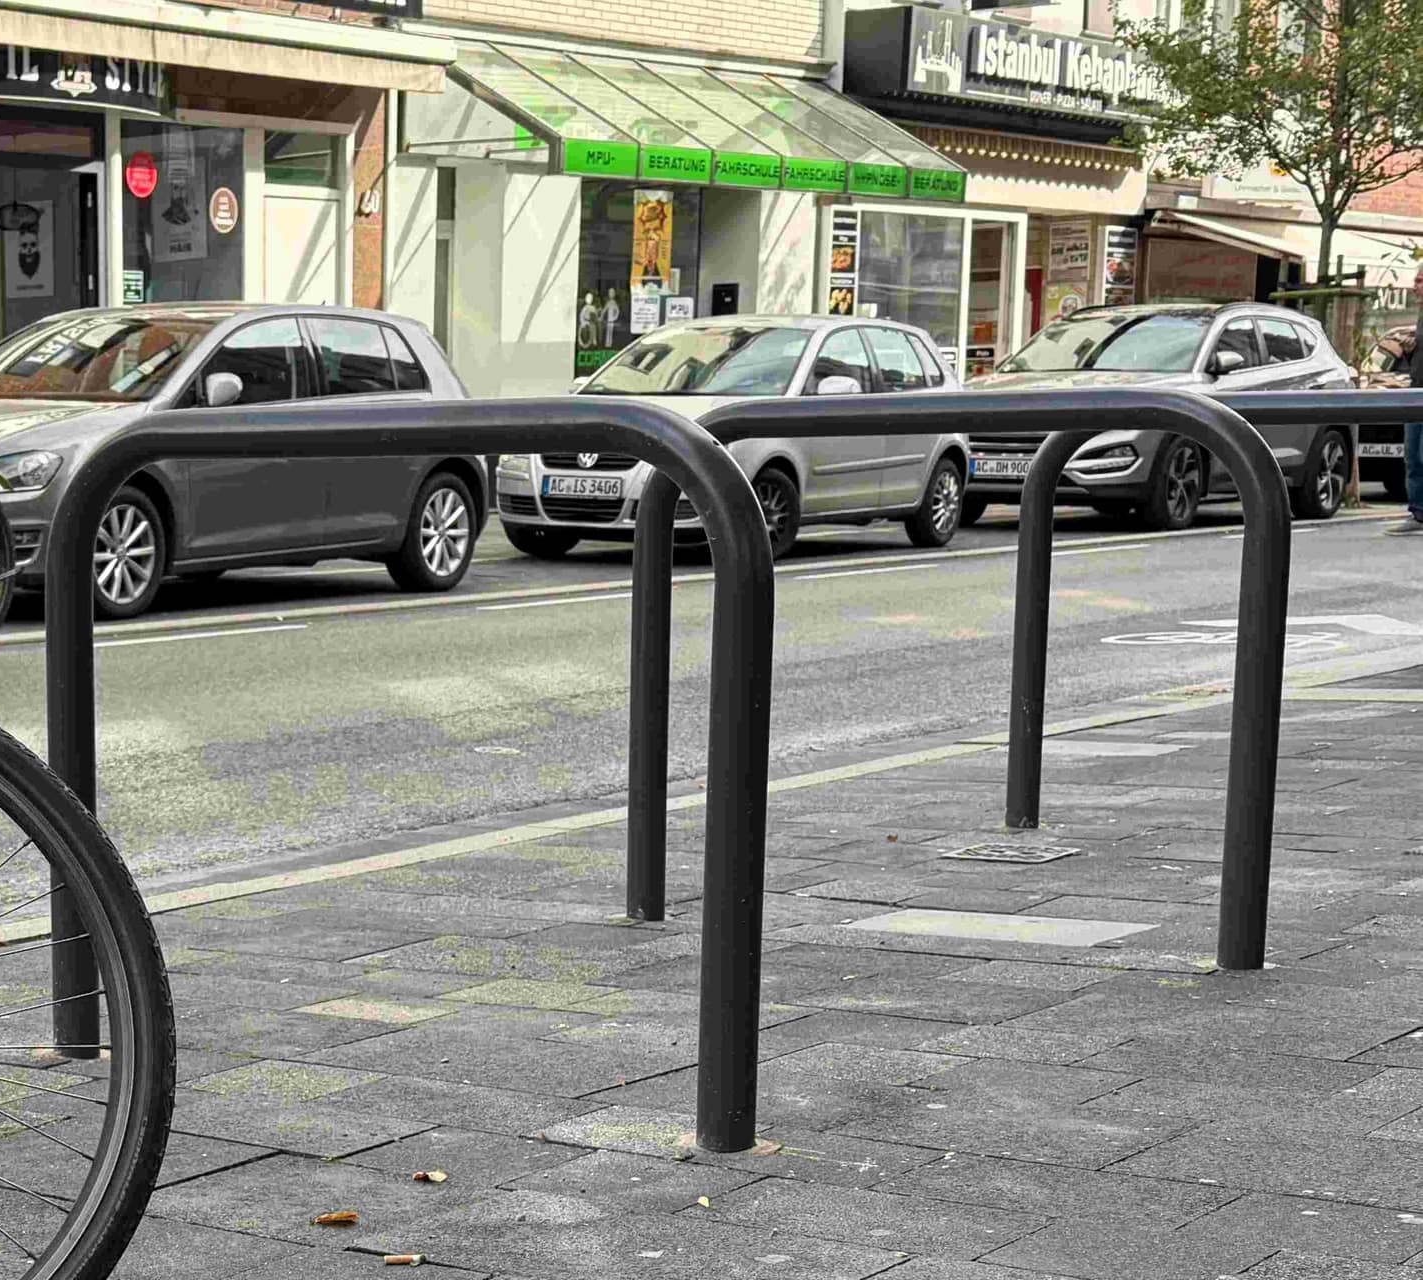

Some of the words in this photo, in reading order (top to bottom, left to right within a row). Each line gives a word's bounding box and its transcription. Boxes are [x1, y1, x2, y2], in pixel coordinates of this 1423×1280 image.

[977, 24, 1062, 86] Istanbul
[585, 149, 616, 166] MPU-
[648, 154, 706, 173] BERATUNG
[714, 160, 781, 179] FAHRSCHULE
[784, 166, 846, 183] FAHRSCHULE
[976, 461, 989, 473] AC
[551, 478, 565, 493] AC
[588, 479, 620, 495] 3406
